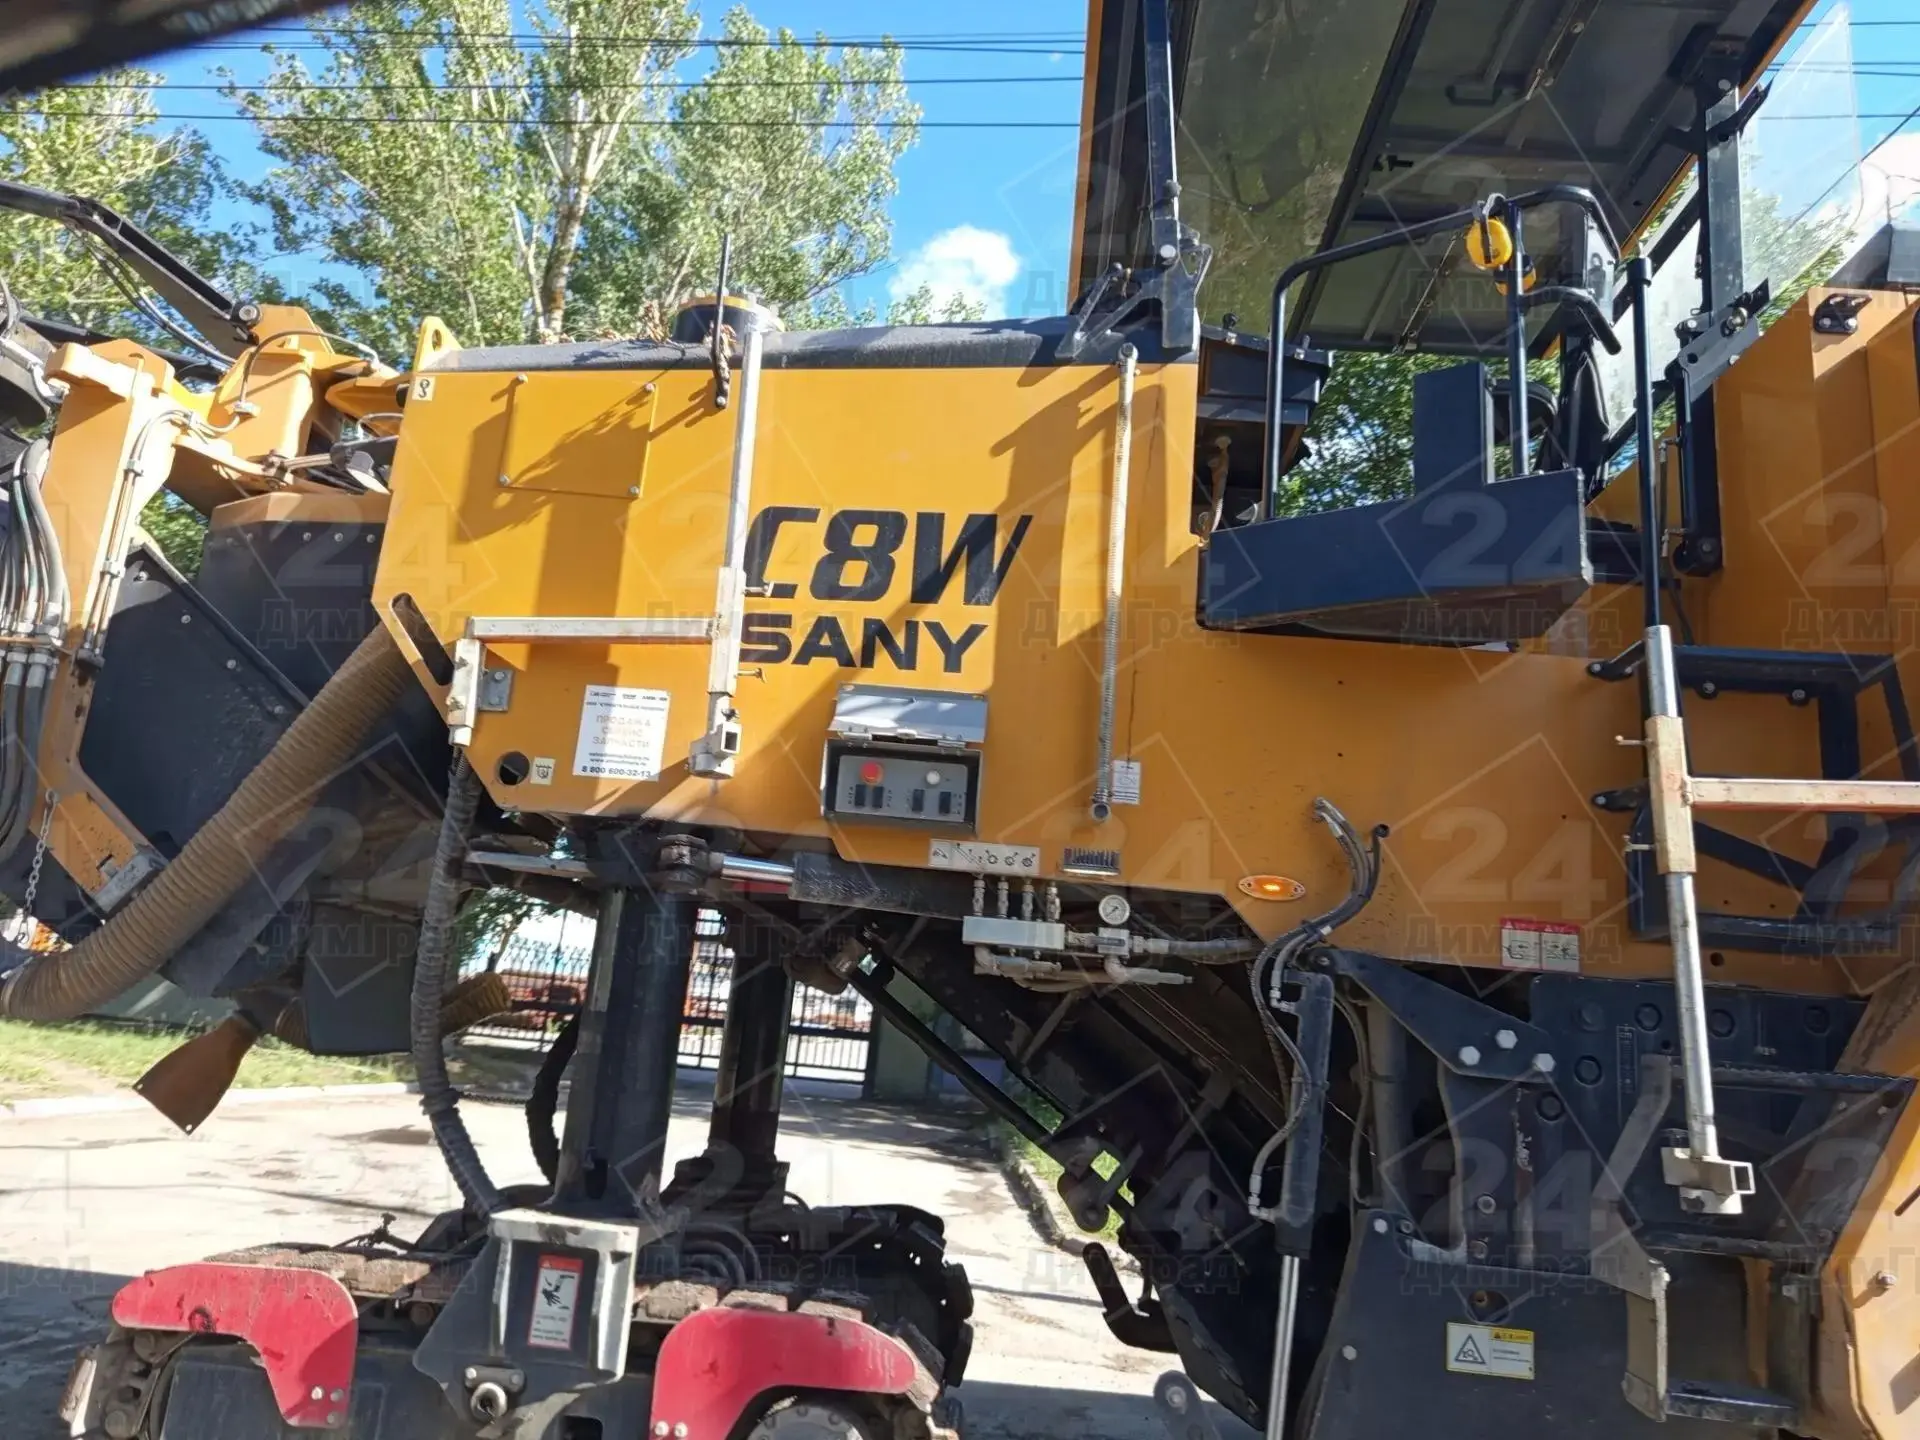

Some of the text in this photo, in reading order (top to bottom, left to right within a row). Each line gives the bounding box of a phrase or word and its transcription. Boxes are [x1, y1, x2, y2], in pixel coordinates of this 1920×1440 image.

[739, 613, 988, 673] SANY
[581, 765, 651, 777] 8 800 600-32-13
